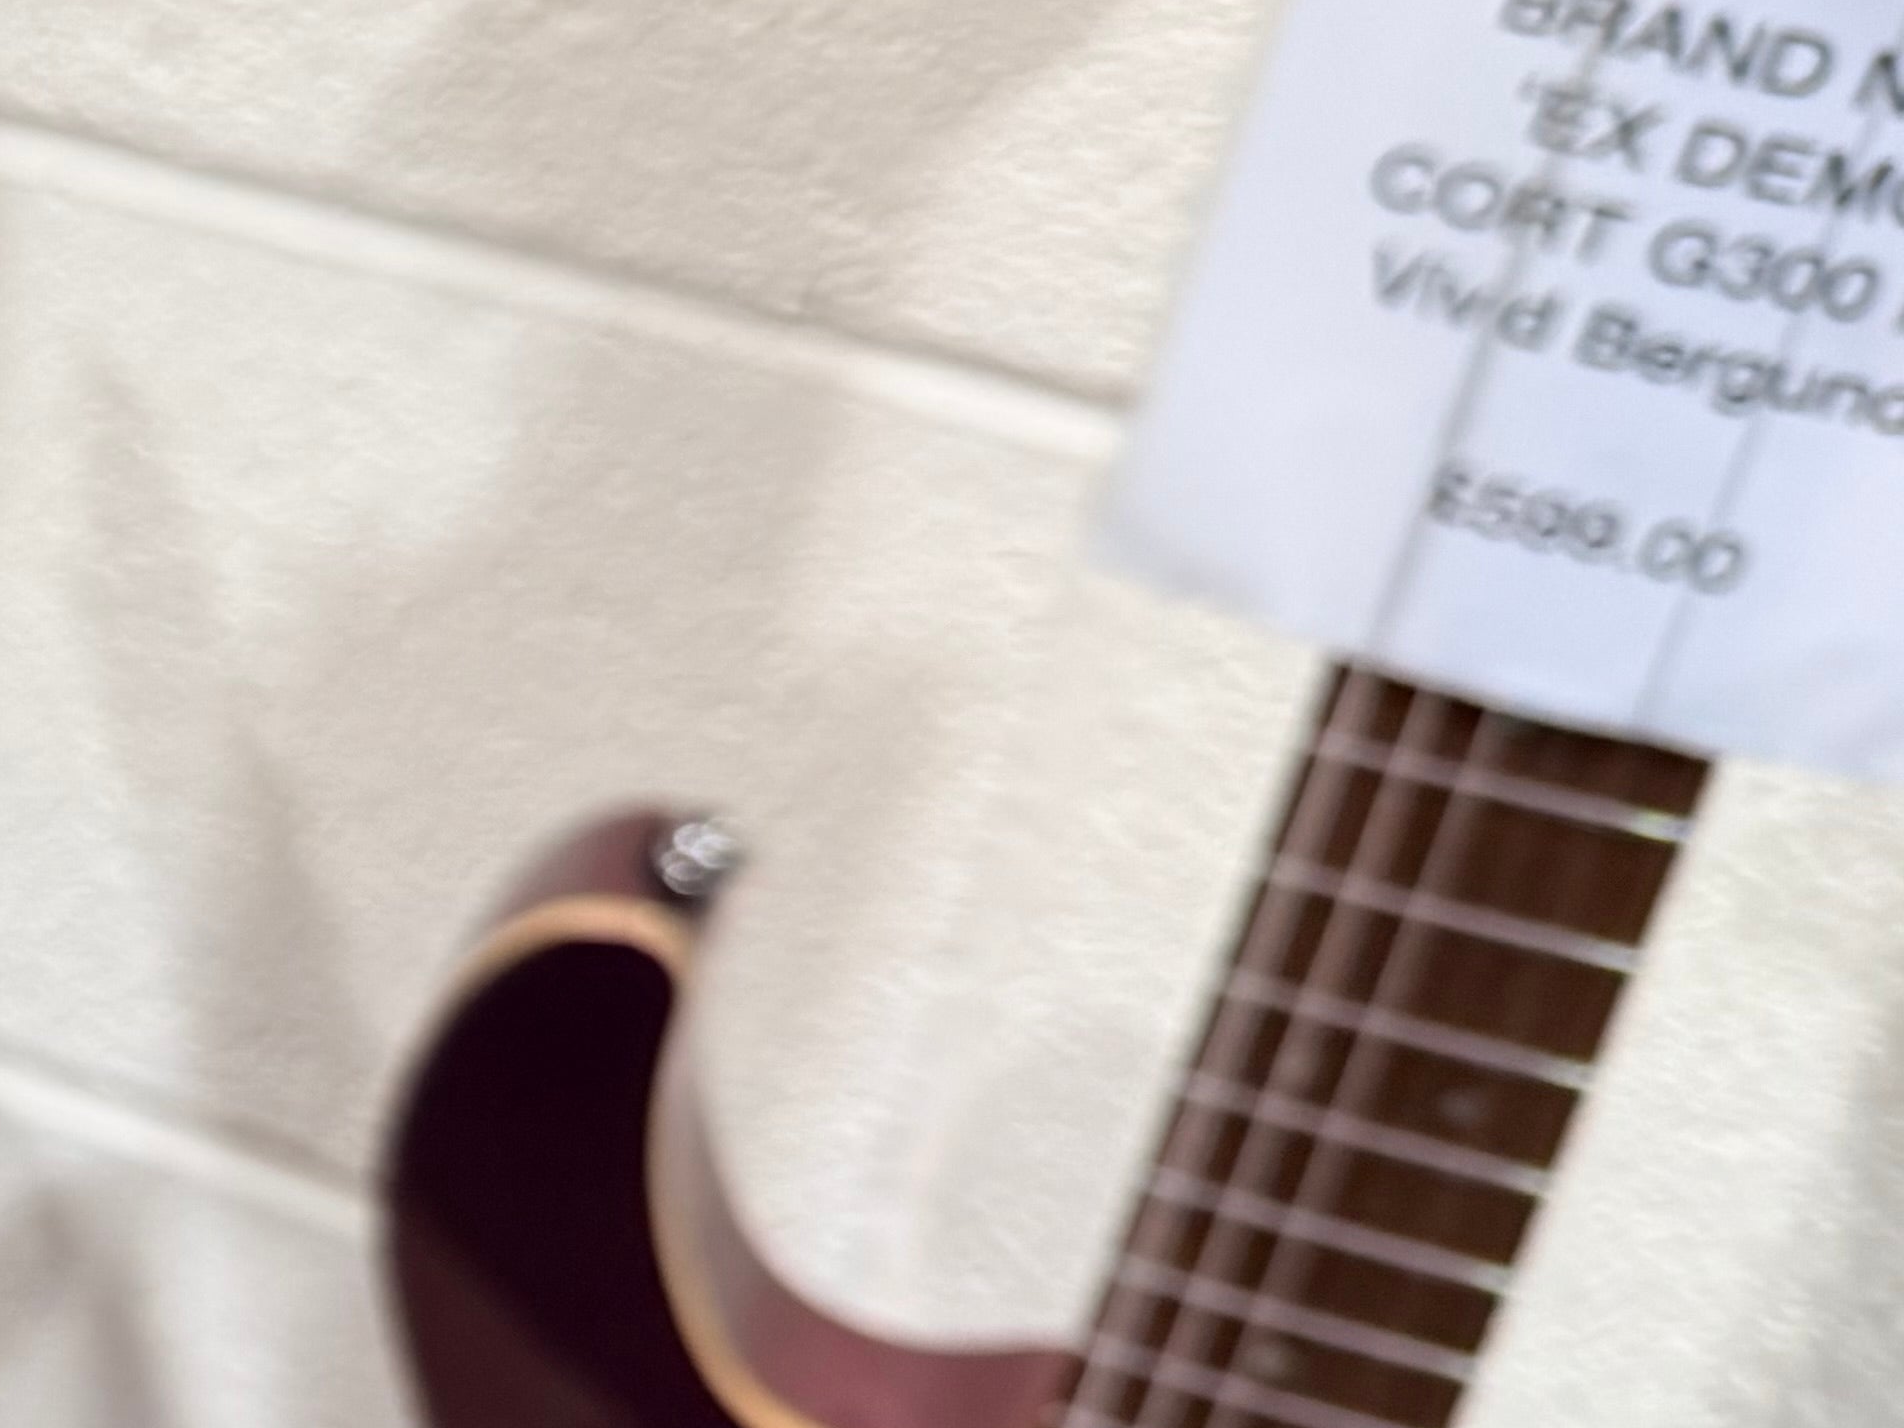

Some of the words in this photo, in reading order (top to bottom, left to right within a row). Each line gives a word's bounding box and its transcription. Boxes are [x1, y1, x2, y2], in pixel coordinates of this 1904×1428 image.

[1673, 119, 1904, 226] DEM
[1370, 142, 1632, 264] CORT
[1648, 217, 1880, 322] G300
[1372, 239, 1562, 353] Vivid
